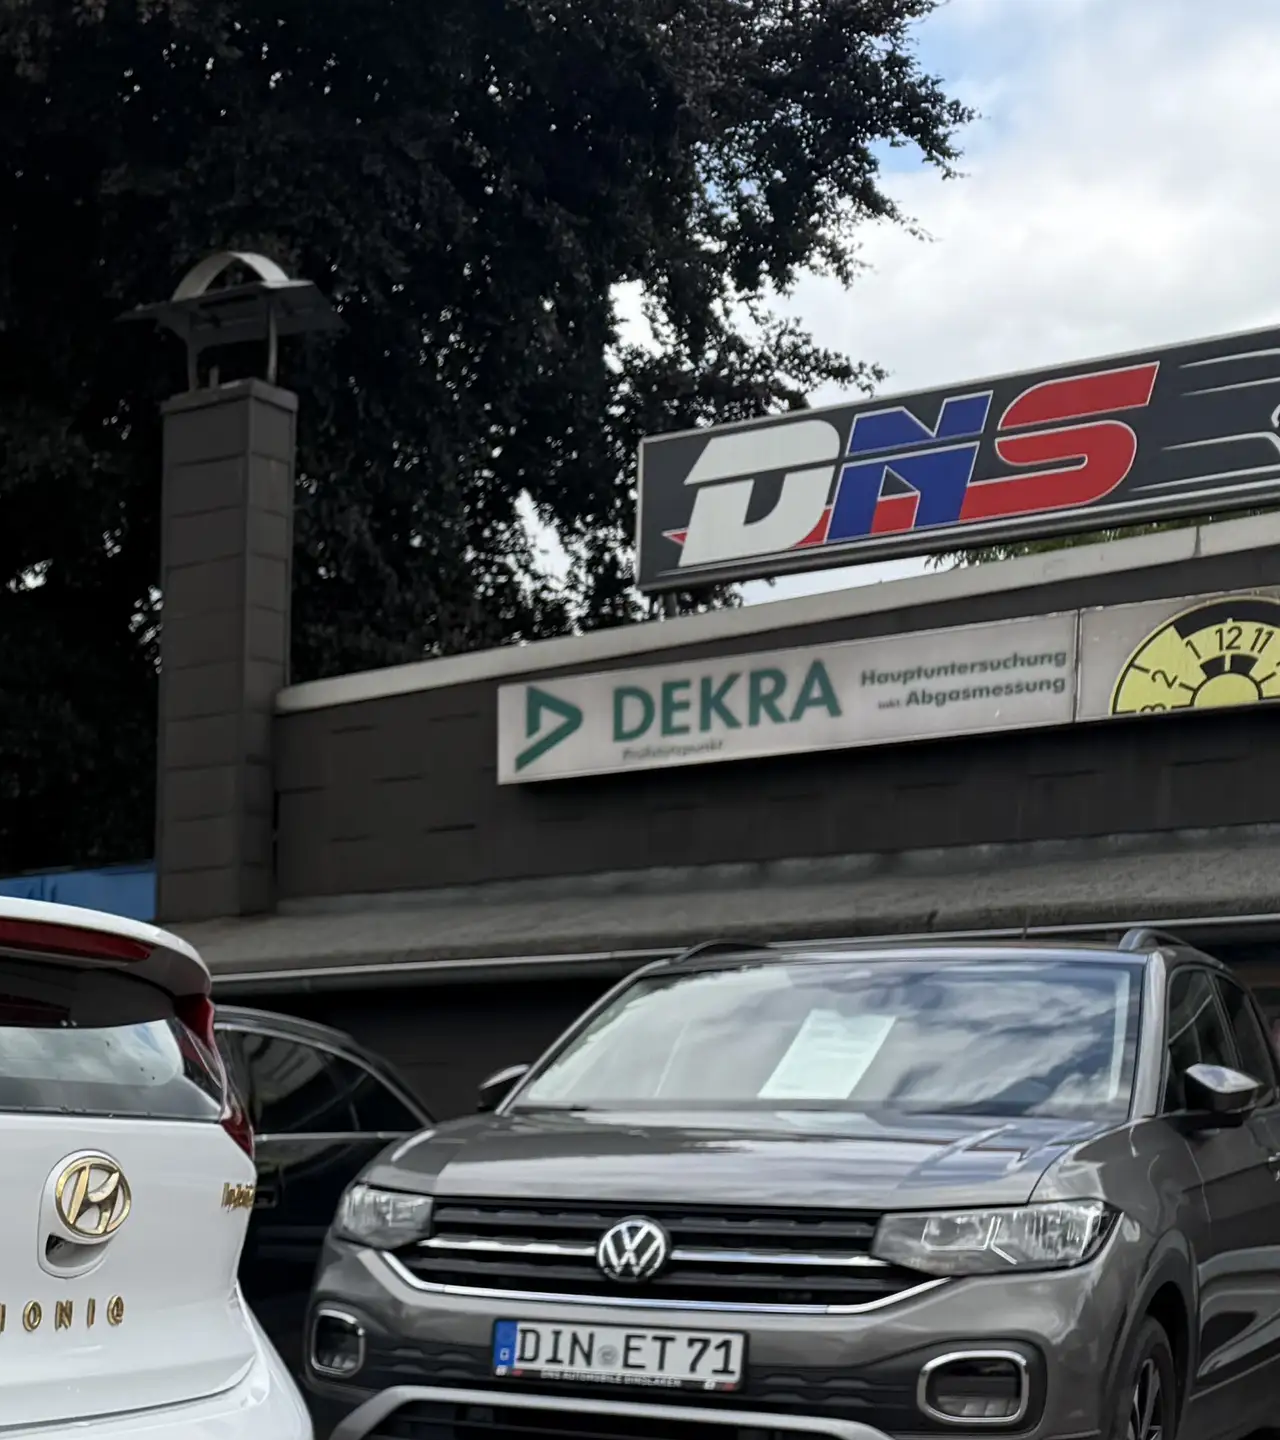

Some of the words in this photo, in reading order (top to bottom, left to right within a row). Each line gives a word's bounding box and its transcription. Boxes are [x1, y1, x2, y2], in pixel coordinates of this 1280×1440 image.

[676, 361, 1160, 567] DNS
[1215, 626, 1243, 651] 12
[1250, 627, 1274, 653] 11
[860, 652, 1067, 686] Hauptuntersuchung
[613, 659, 843, 743] DEKRA
[905, 677, 1066, 707] Abgasmessung
[517, 1329, 594, 1367] DIN
[622, 1335, 676, 1371] ET
[687, 1337, 735, 1376] 71
